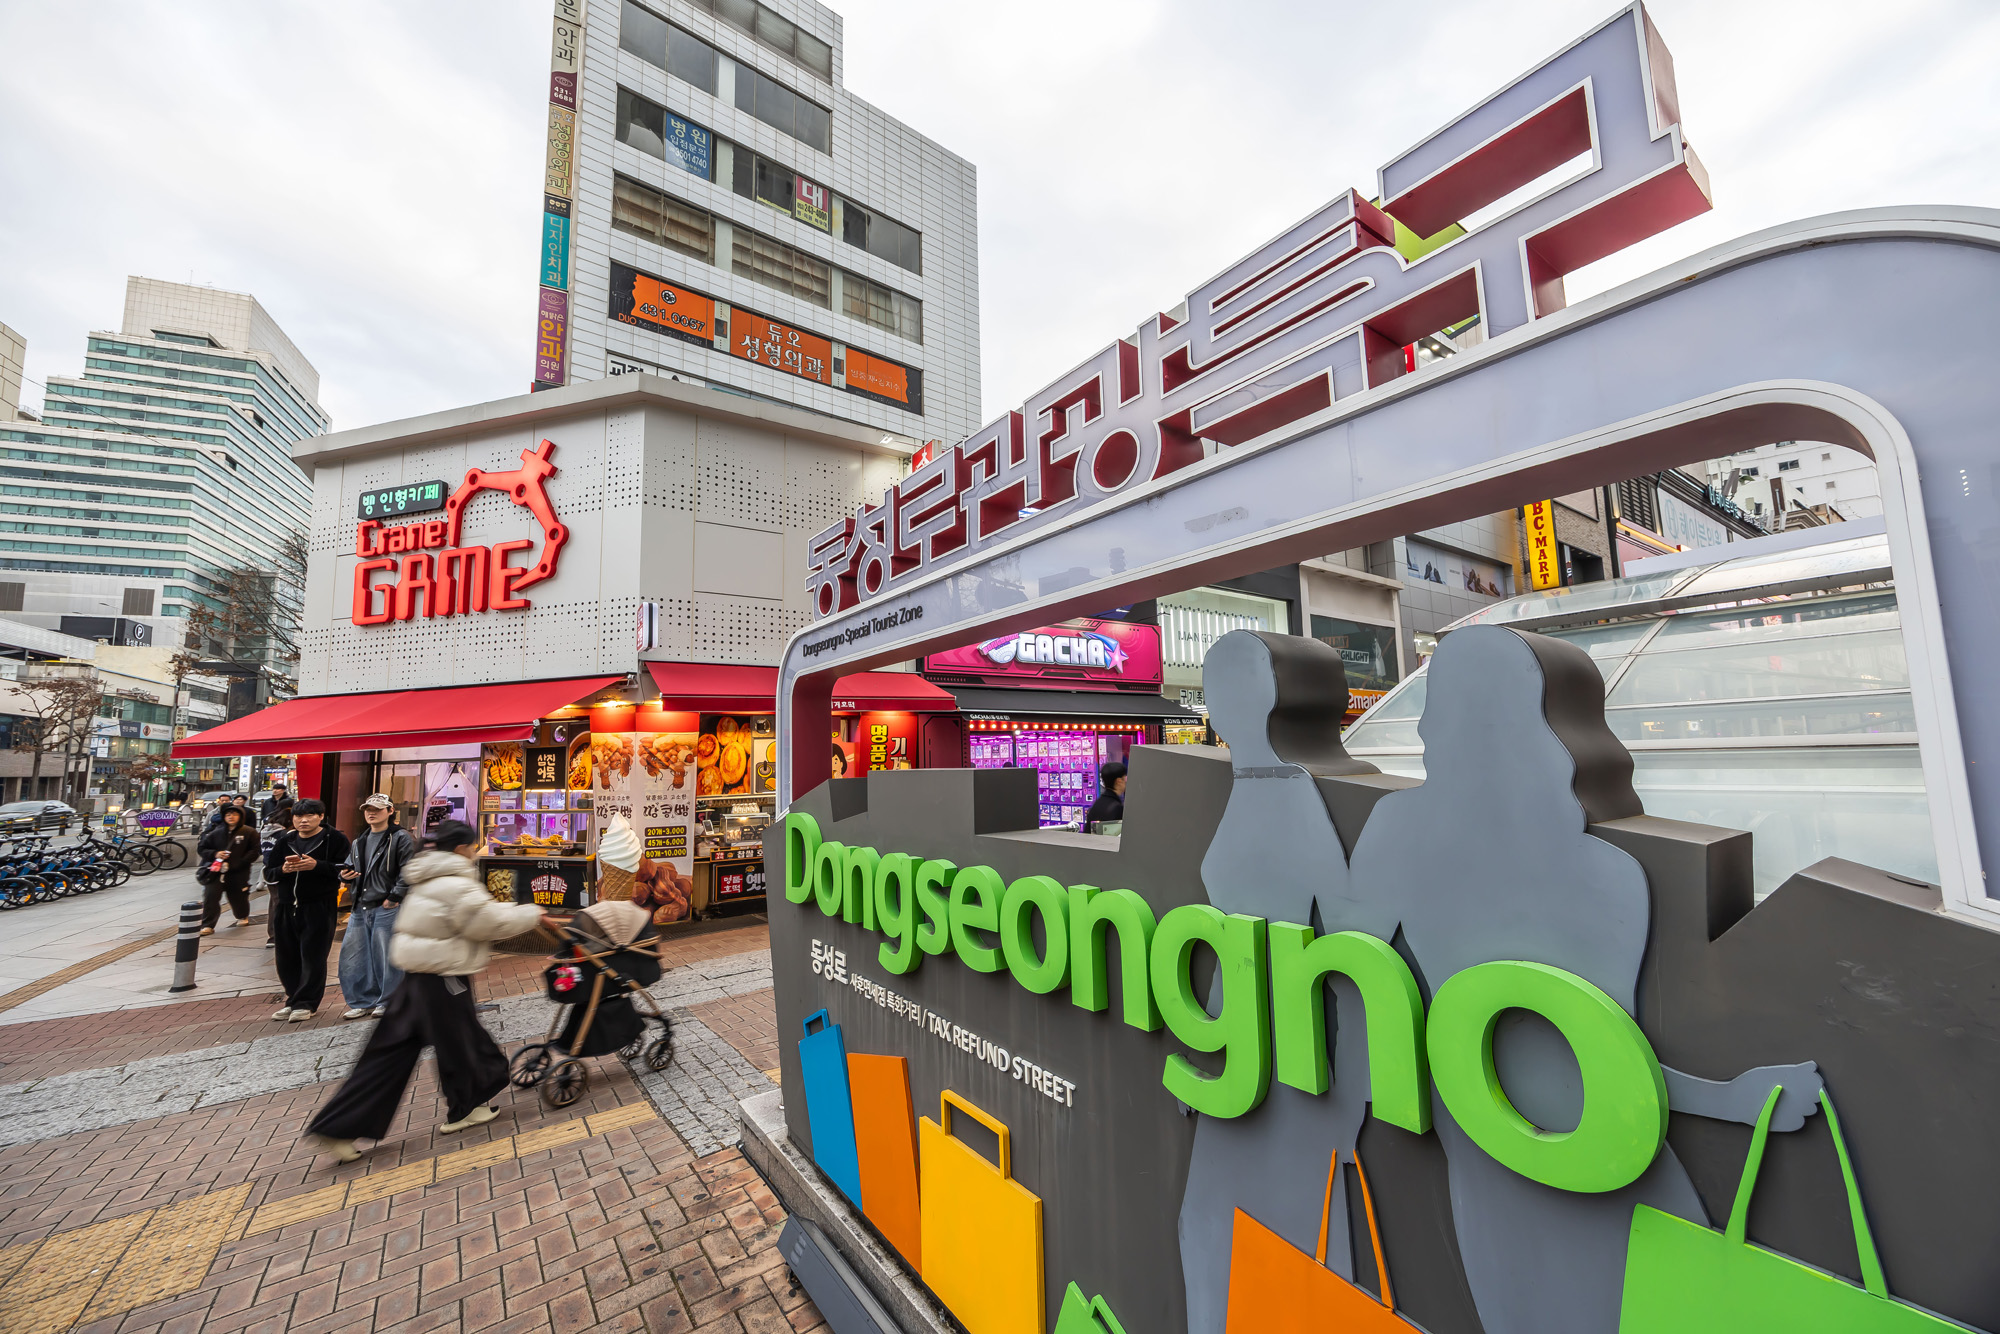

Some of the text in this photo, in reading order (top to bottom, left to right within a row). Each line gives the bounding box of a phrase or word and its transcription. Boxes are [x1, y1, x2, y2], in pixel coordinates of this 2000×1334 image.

[555, 27, 577, 66] 안과
[547, 121, 571, 195] 성형외과
[802, 180, 823, 210] 대
[547, 216, 563, 287] 디자인치과
[619, 313, 636, 325] DUO
[640, 303, 705, 332] 431.0057
[540, 319, 564, 361] 안과
[767, 323, 801, 348] 듀오
[540, 359, 560, 371] 의원
[740, 334, 824, 381] 성형외과
[544, 370, 556, 380] 4F
[380, 483, 439, 513] 인형카페
[356, 520, 448, 557] Crane
[352, 539, 534, 626] GAME
[803, 605, 923, 657] Dongseongno Special Tourist Zone
[1178, 631, 1213, 643] MANGO
[1018, 632, 1106, 668] GACHA
[537, 753, 556, 767] 삼진
[537, 767, 556, 782] 어묵
[537, 860, 560, 869] 삼진어묵
[533, 891, 565, 905] 따뜻한 어묵
[720, 884, 741, 894] 호떡
[785, 812, 1670, 1193] Dongseongno
[810, 938, 849, 985] 동성로
[849, 972, 887, 1008] 사후면세점
[886, 991, 922, 1027] 특화거리
[927, 1011, 951, 1042] TAX
[953, 1024, 1011, 1072] REFUND
[1012, 1055, 1076, 1107] STREET
